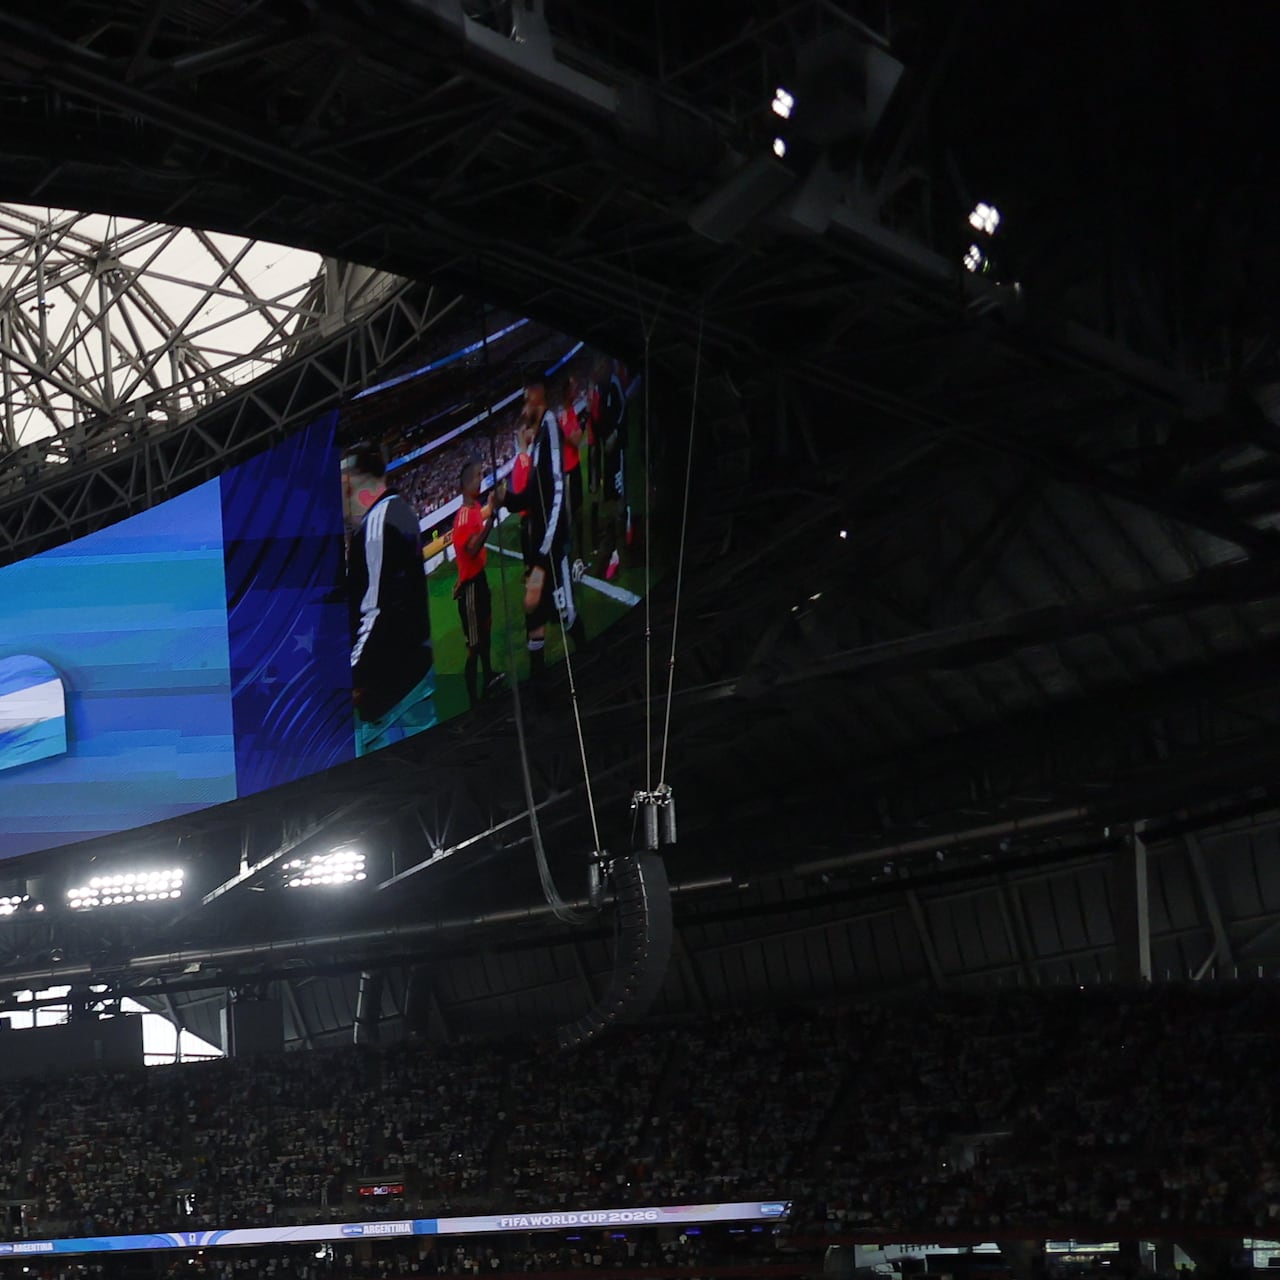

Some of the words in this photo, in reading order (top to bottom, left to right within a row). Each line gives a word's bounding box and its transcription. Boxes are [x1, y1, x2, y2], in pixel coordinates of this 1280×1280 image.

[500, 1216, 529, 1228] FIFA
[530, 1214, 578, 1226] WORLD
[579, 1212, 607, 1224] CUP
[608, 1210, 658, 1222] 2026
[363, 1221, 411, 1234] ARGENTINA
[12, 1242, 54, 1253] ARGENTINA
